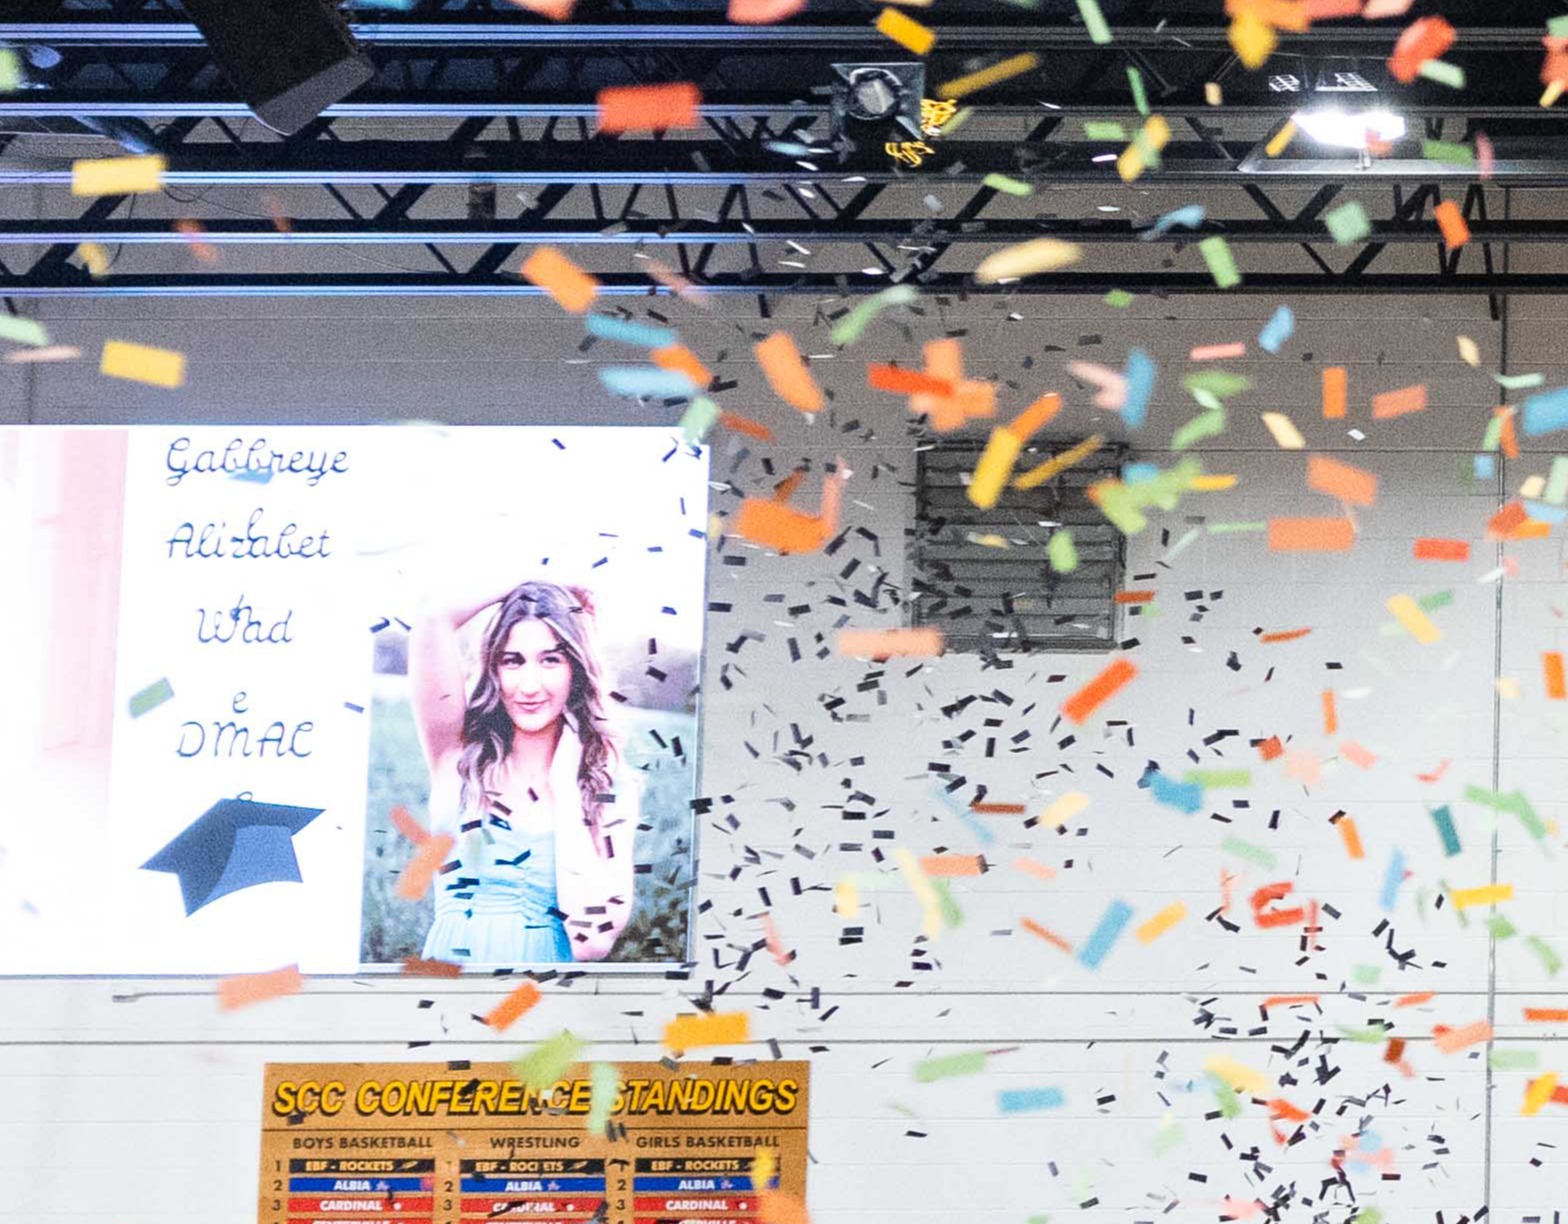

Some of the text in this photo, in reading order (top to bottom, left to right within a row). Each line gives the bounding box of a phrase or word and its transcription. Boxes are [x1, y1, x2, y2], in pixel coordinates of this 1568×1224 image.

[272, 1078, 799, 1117] SCC CONFERENCE STANDINGS
[293, 1136, 433, 1149] BOYS BASKETBALL
[490, 1136, 580, 1149] WRESTLING
[636, 1135, 780, 1149] GIRLS BASKETBALL
[275, 1160, 281, 1173] 1
[306, 1161, 328, 1171] EBF
[340, 1161, 394, 1171] ROCKETS
[476, 1161, 498, 1172] EBF
[510, 1161, 564, 1171] ROCETS
[651, 1160, 673, 1171] EBF
[685, 1160, 739, 1171] ROCKETS
[274, 1180, 371, 1191] 2 ALBIA
[444, 1181, 543, 1192] 2 ALBIA
[617, 1179, 715, 1191] 2 ALBIA
[272, 1200, 383, 1211] 3 CARDINAL
[443, 1200, 452, 1211] 3
[616, 1199, 729, 1210] 3 CARDINAL
